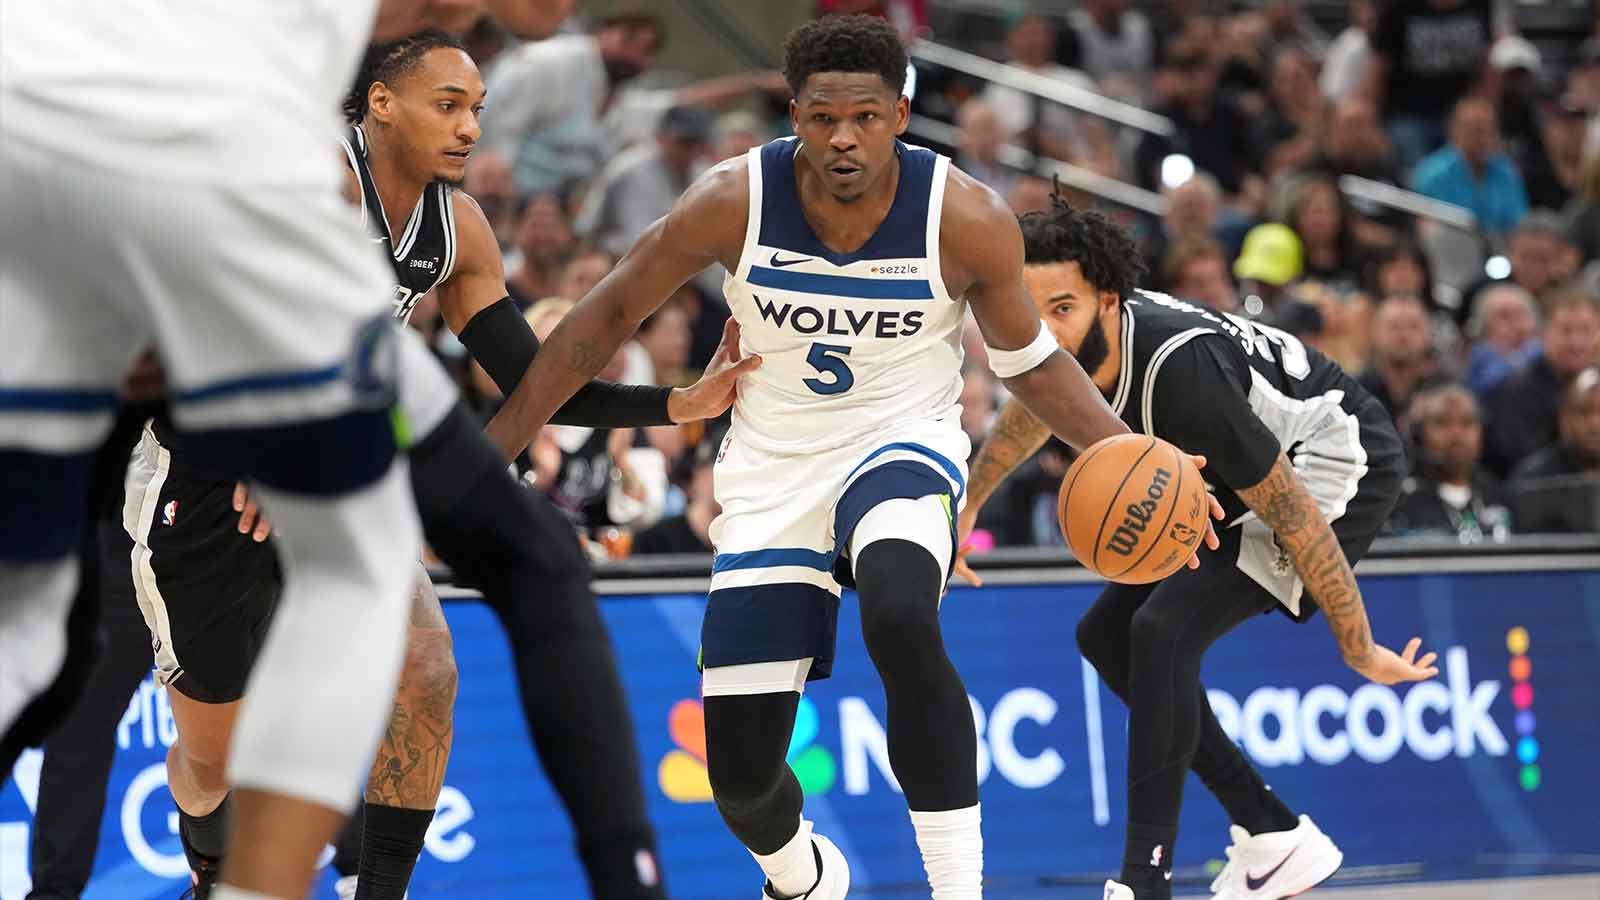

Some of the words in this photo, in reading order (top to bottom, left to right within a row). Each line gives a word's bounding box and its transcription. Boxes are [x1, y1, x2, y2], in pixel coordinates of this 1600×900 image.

[879, 263, 918, 274] sezzle
[752, 293, 925, 339] WOLVES
[802, 342, 855, 396] 5
[1105, 467, 1172, 557] Wilson
[837, 686, 1066, 797] NC
[1205, 645, 1510, 768] acock
